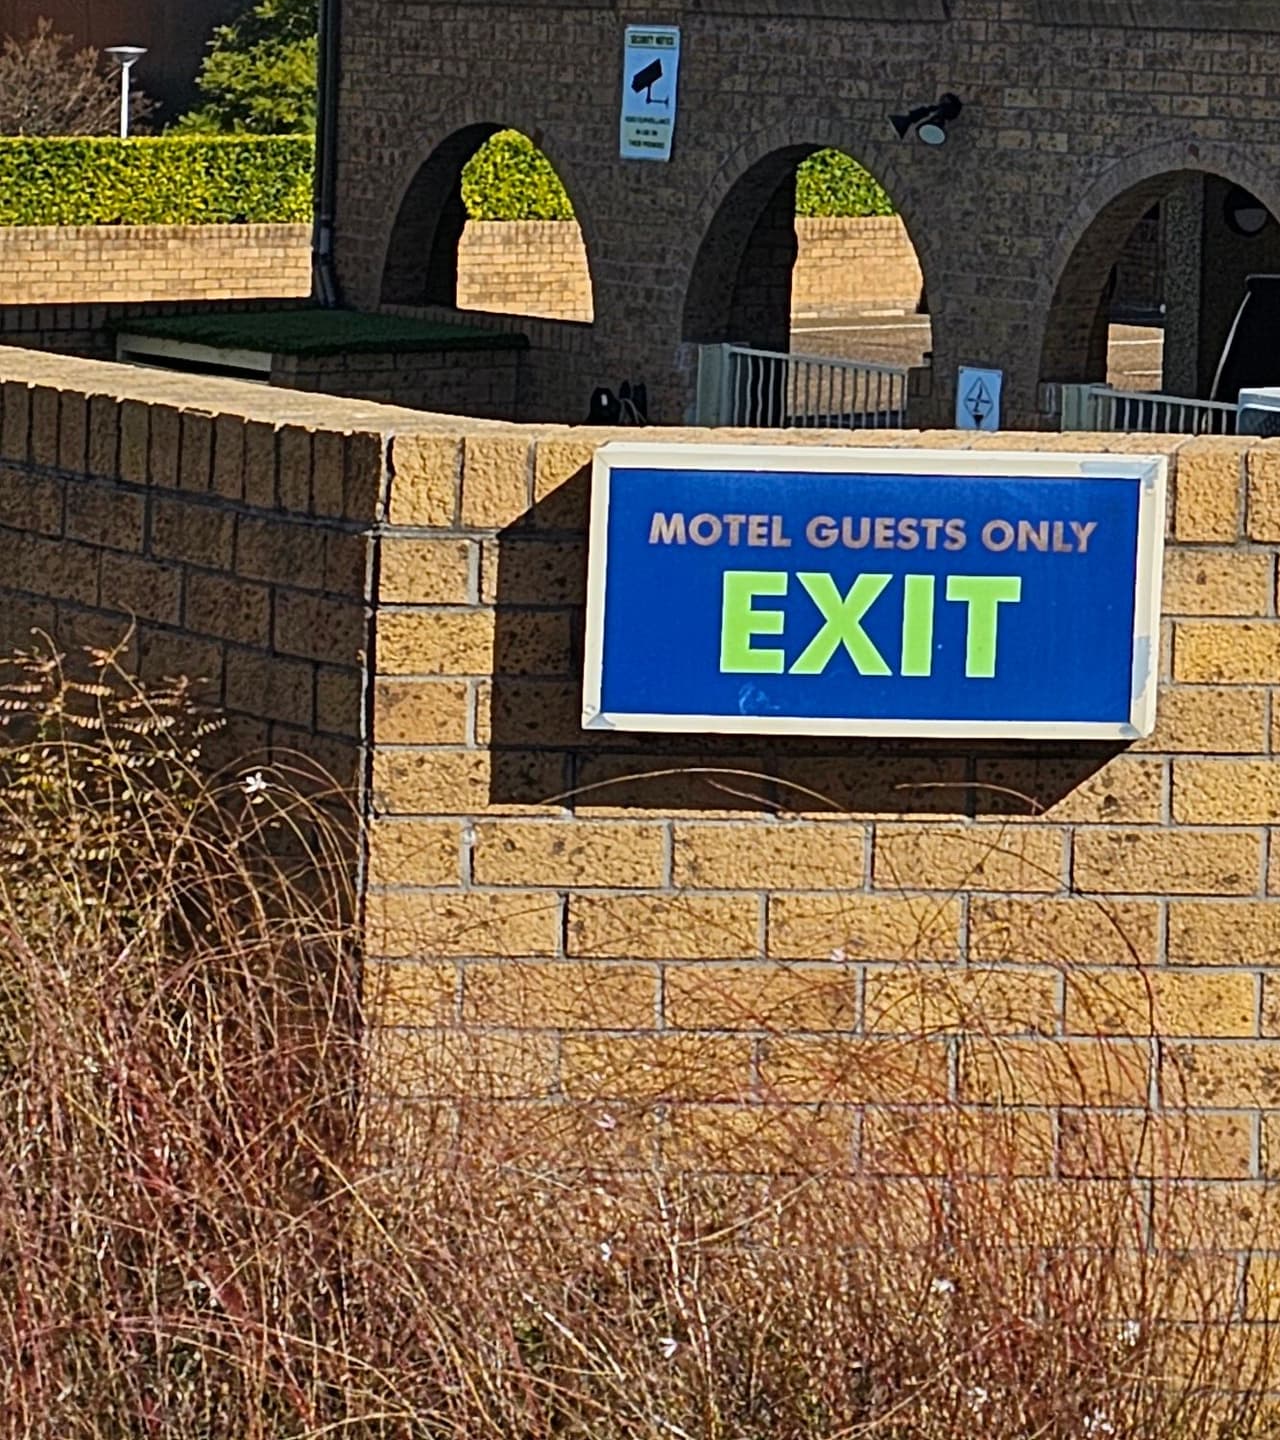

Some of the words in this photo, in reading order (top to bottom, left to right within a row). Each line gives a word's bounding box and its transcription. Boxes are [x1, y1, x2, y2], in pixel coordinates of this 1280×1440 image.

[649, 512, 791, 548] MOTEL
[805, 516, 966, 550] GUESTS
[981, 519, 1098, 553] ONLY
[719, 570, 1021, 678] EXIT
